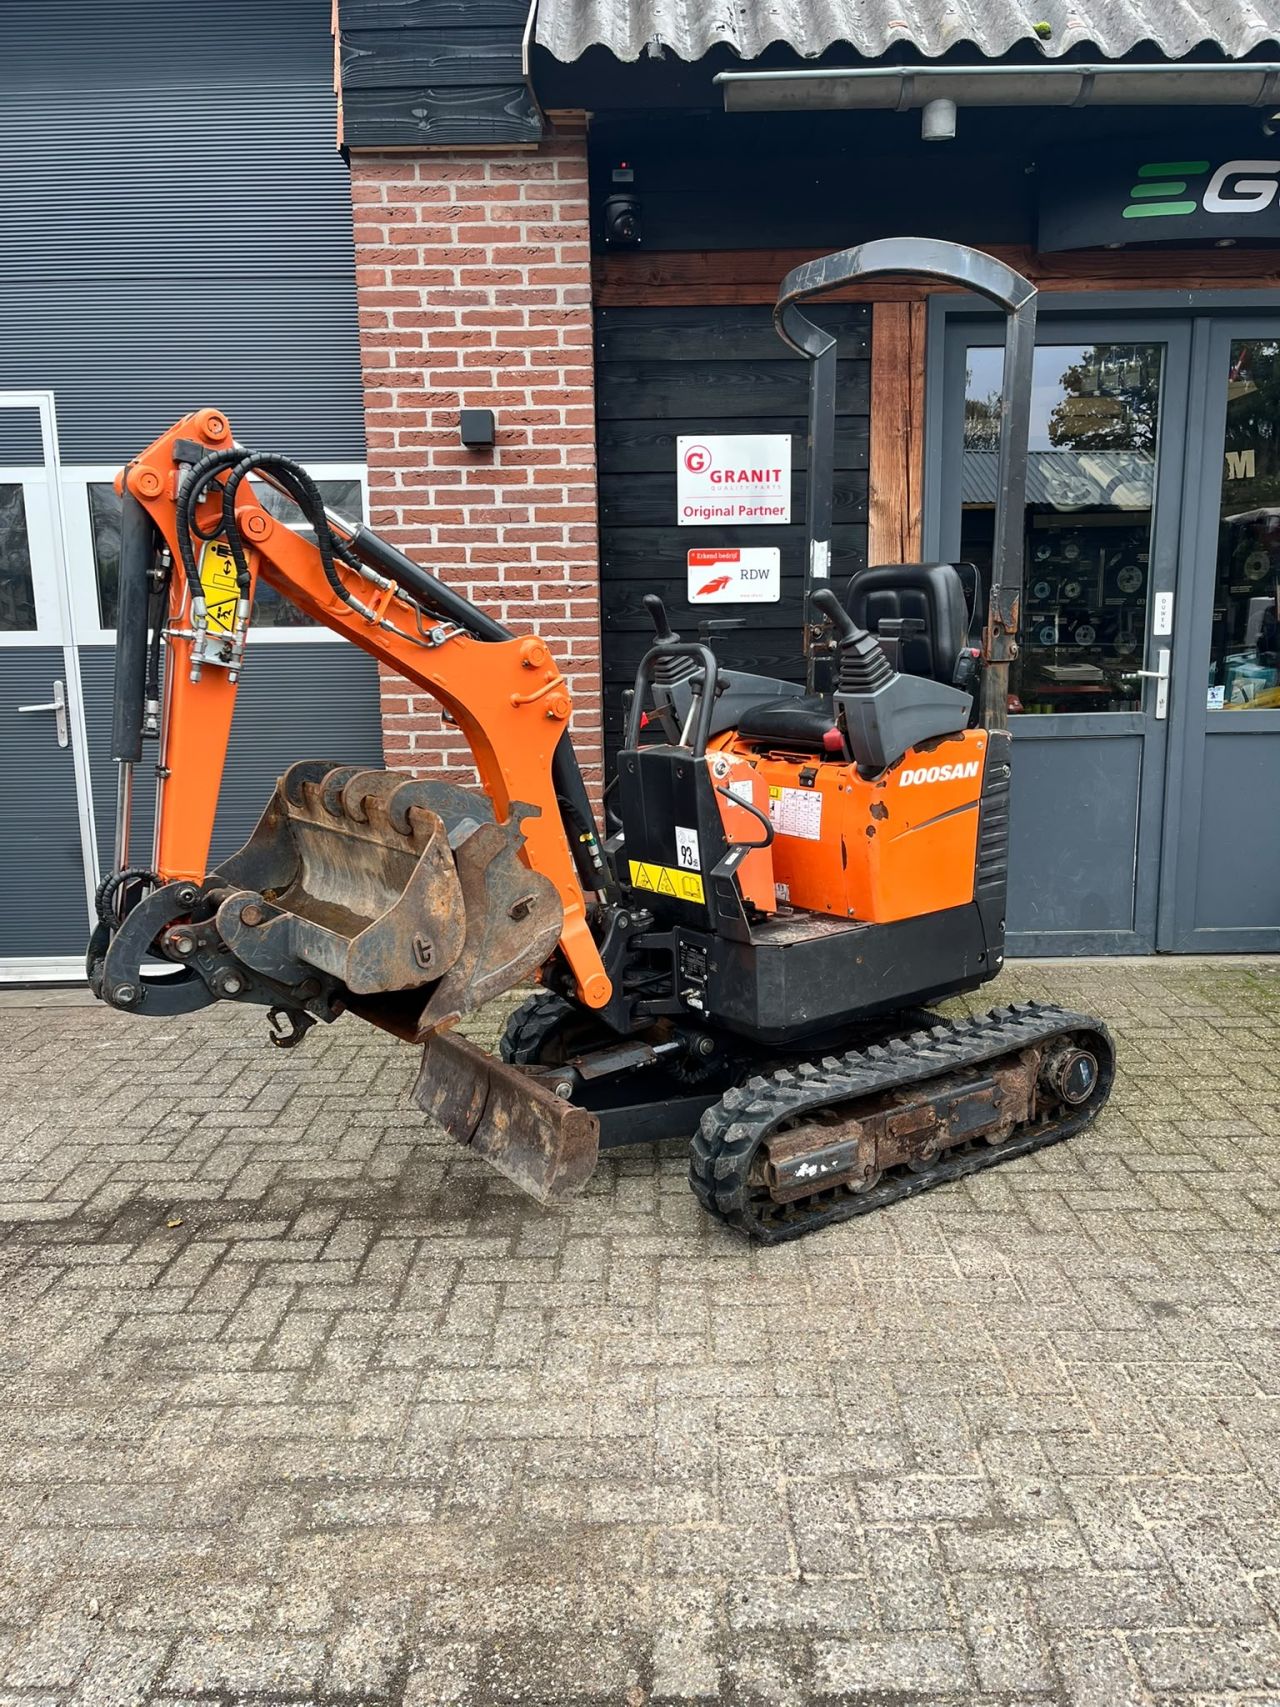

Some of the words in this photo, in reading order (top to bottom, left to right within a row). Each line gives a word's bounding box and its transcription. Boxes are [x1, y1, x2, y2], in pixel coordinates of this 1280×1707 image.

[1122, 160, 1280, 218] EG
[687, 453, 704, 471] G
[710, 469, 782, 483] GRANIT
[683, 505, 735, 519] Original
[738, 505, 785, 516] Partner
[740, 569, 770, 580] RDW
[899, 761, 979, 787] DOOSAN
[681, 845, 693, 866] 93
